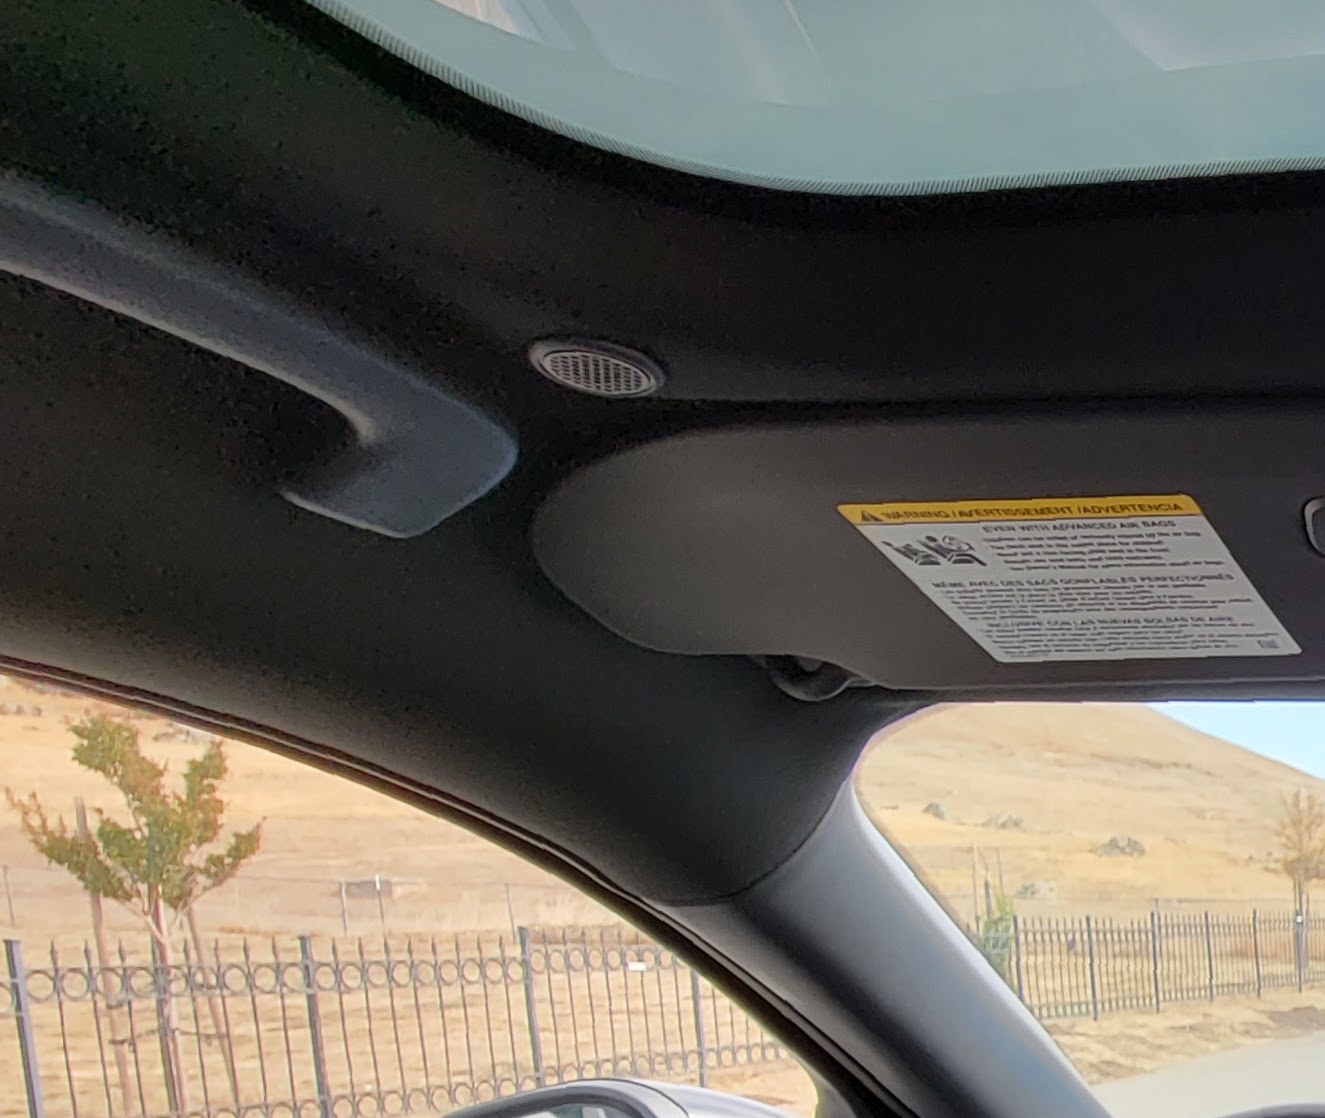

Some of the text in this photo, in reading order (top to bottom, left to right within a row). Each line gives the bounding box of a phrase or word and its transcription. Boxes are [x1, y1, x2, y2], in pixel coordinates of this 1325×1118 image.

[882, 510, 950, 520] WARNING
[1018, 524, 1050, 532] WITH
[1052, 521, 1117, 531] ADVANCED
[1120, 520, 1140, 530] AIR
[1141, 519, 1177, 528] BAGS
